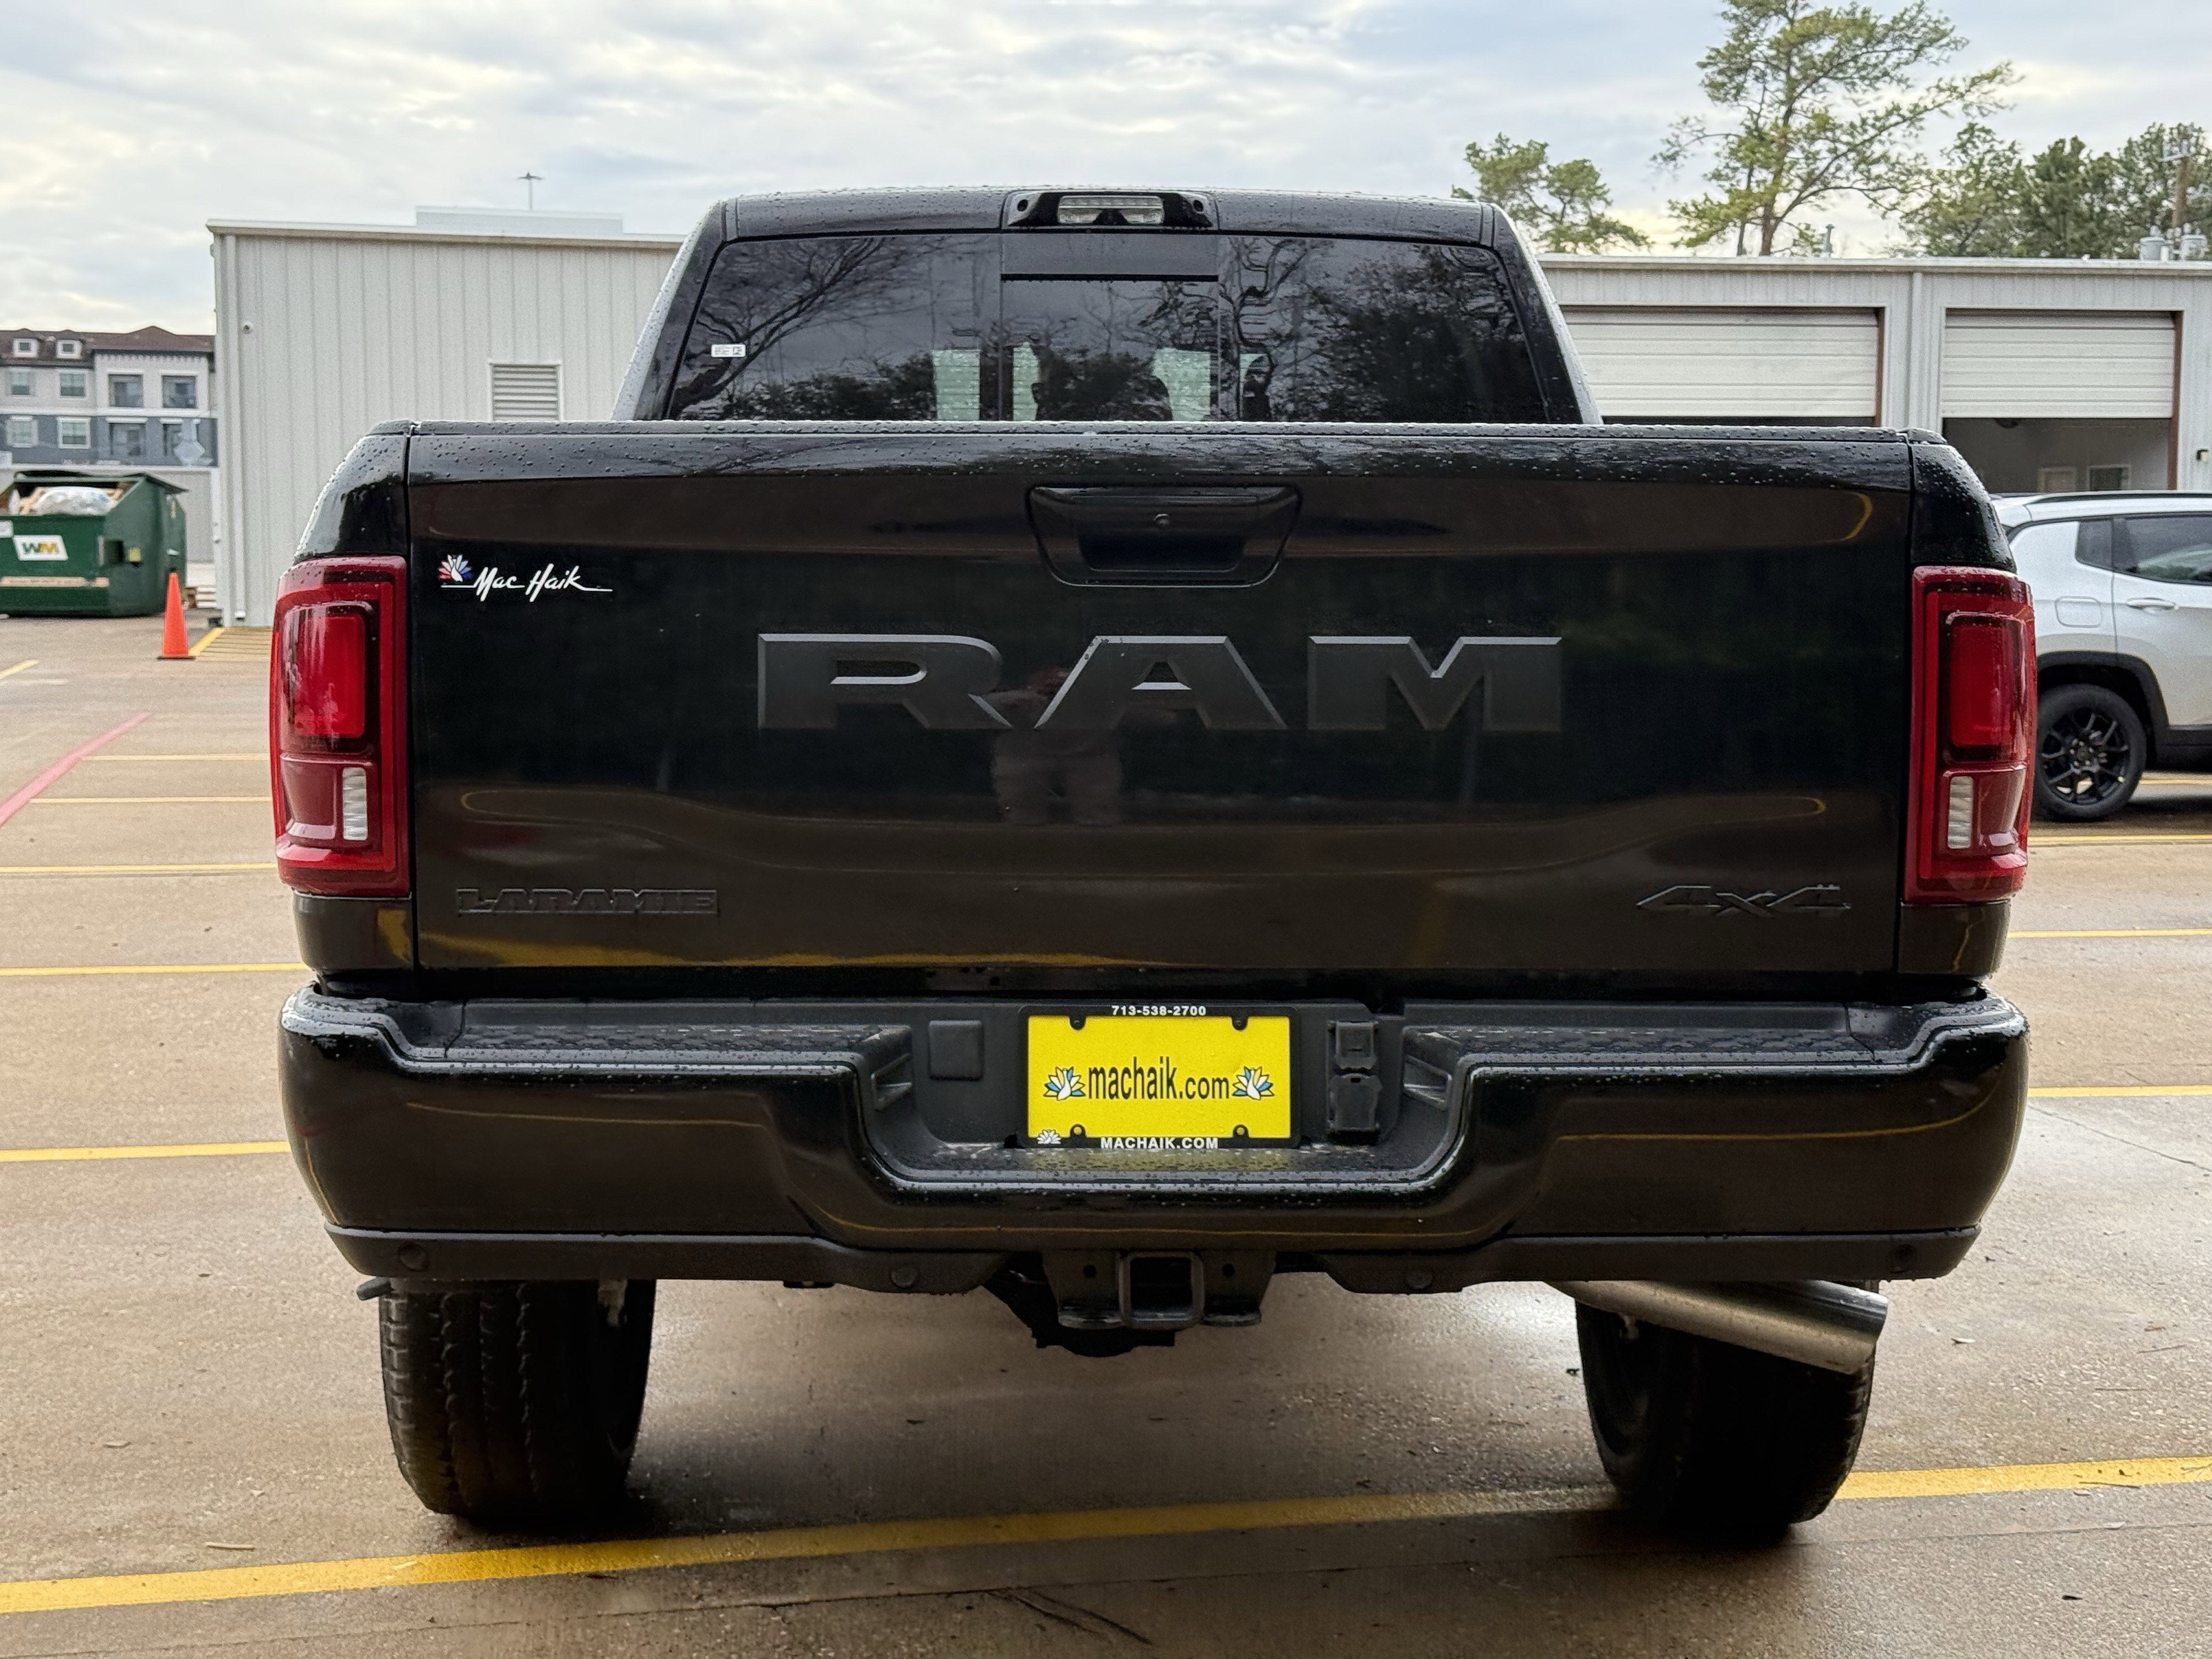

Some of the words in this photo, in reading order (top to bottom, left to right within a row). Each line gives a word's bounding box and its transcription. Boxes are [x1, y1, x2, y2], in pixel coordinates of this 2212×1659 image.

[22, 541, 59, 555] WM
[472, 567, 525, 602] Mac
[525, 563, 613, 602] Haik
[758, 633, 1562, 731] RAM
[456, 888, 719, 915] LARAMIE
[1111, 1005, 1207, 1016] 713-538-2700
[1088, 1056, 1230, 1100] machaik.com
[1100, 1137, 1219, 1150] MACHAIK.COM
